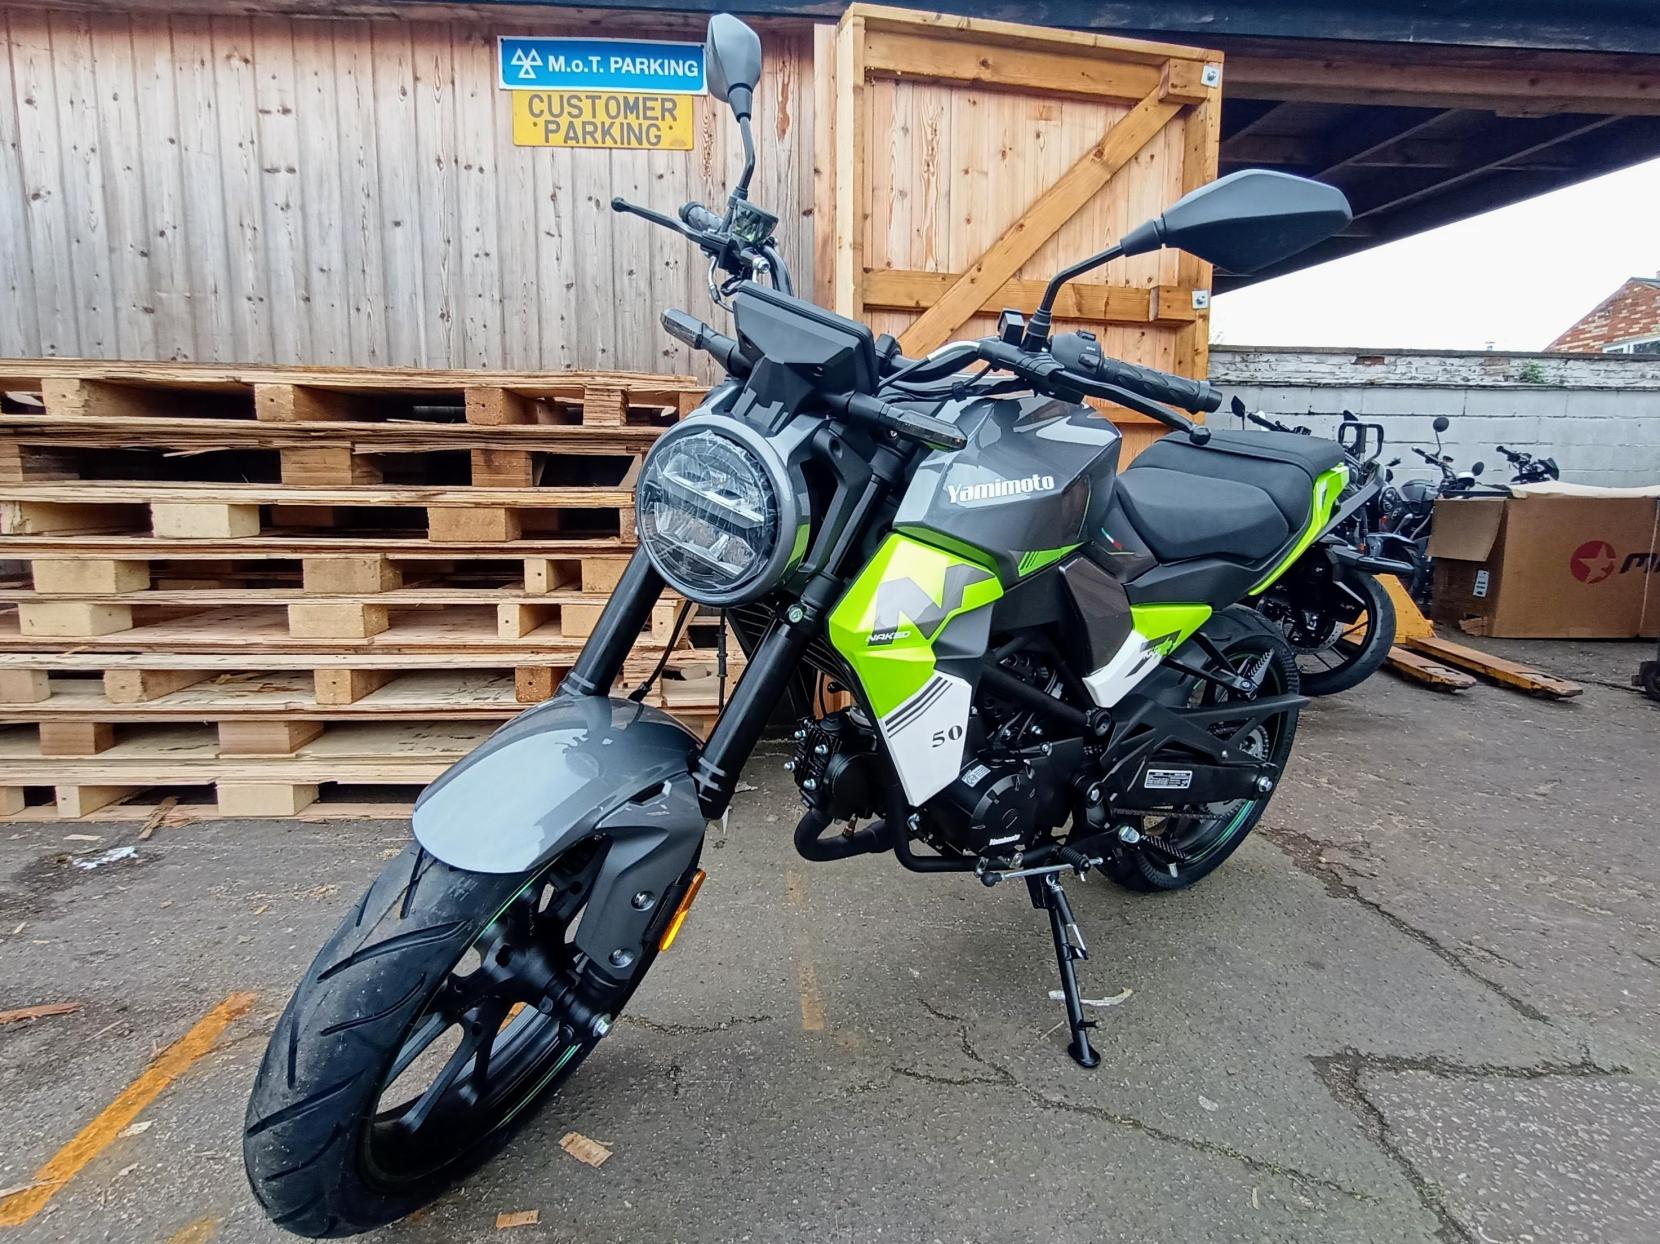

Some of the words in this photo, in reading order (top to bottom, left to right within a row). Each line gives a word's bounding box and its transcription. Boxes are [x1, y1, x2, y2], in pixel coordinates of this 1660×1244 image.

[610, 57, 699, 77] PARKING
[528, 94, 678, 122] CUSTOMER
[543, 119, 662, 146] PARKING
[947, 474, 1055, 503] Yamimoto
[932, 725, 963, 748] 50
